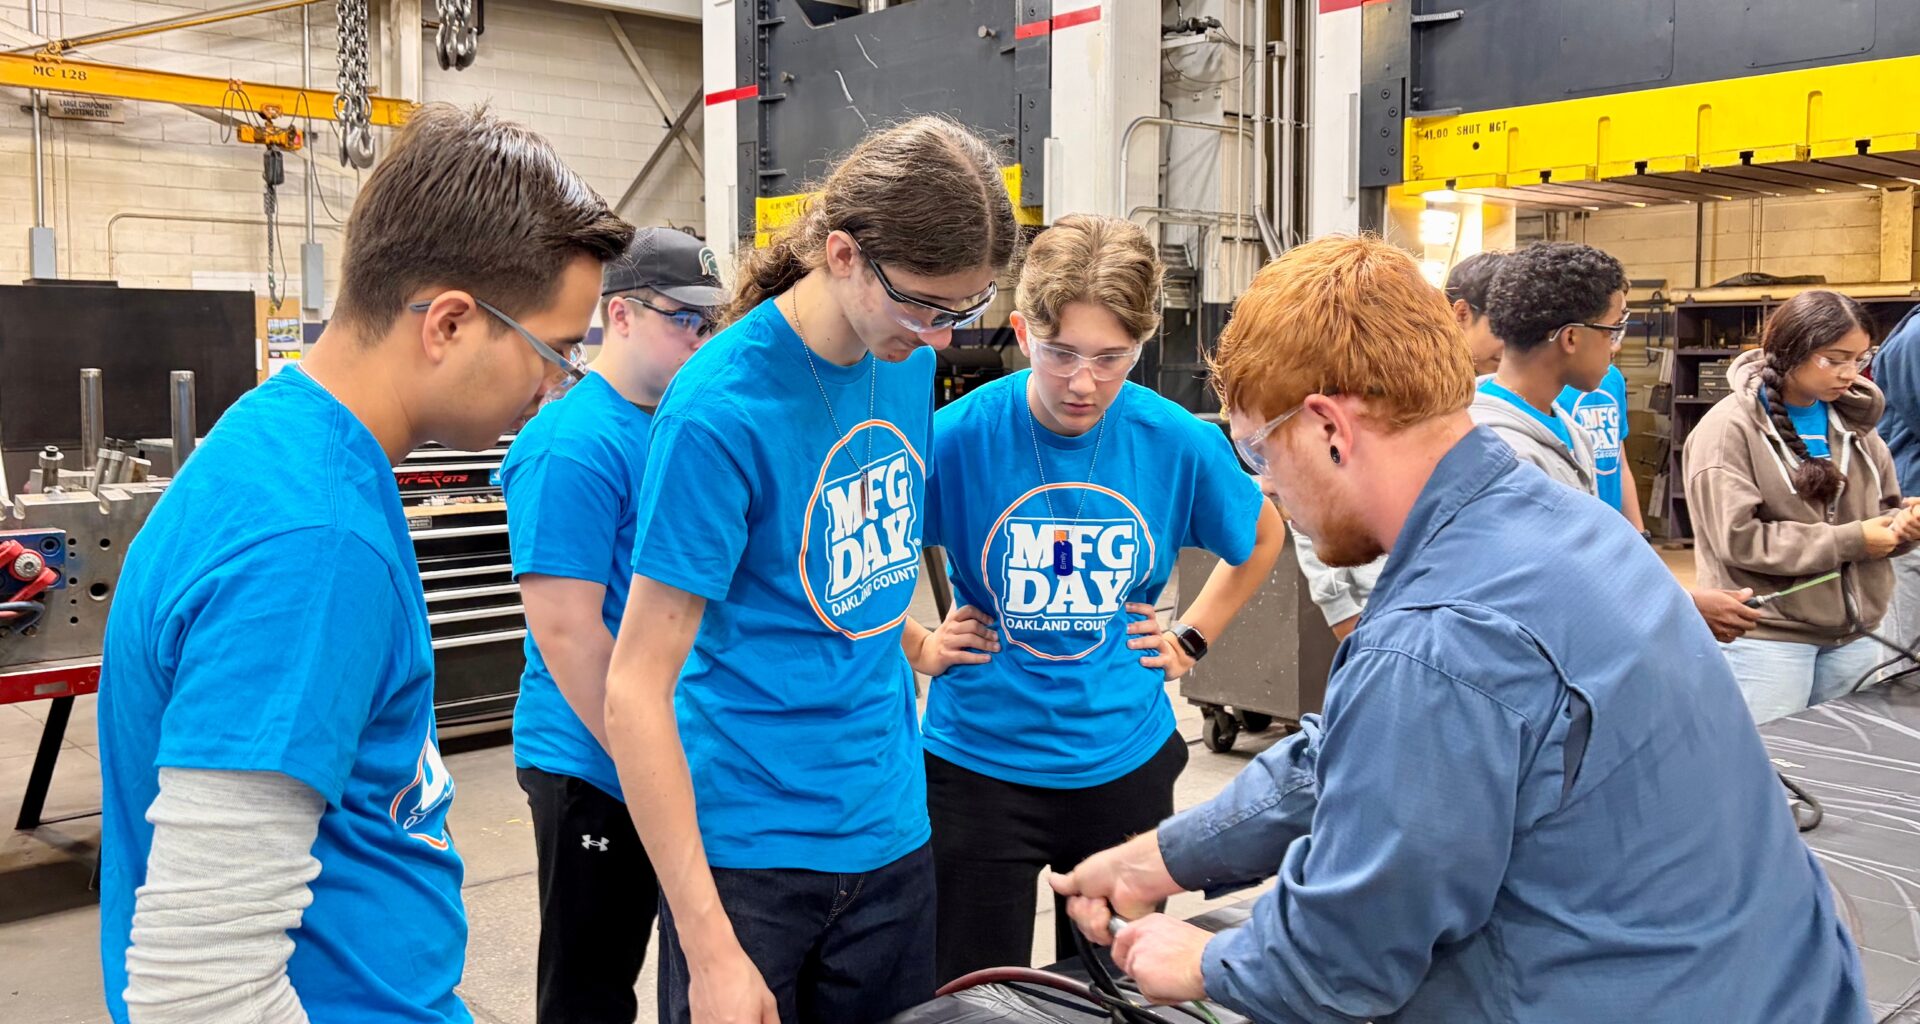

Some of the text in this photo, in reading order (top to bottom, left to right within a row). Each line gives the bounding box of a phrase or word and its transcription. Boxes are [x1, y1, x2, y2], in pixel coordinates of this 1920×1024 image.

[33, 65, 87, 80] MC 128
[59, 100, 112, 110] LARGE COMPONENT
[63, 107, 110, 118] SPOTTING CELL
[1424, 127, 1449, 140] 41.00
[1456, 123, 1481, 136] SHUT
[1579, 406, 1618, 430] MFG
[442, 474, 468, 483] GTS
[827, 456, 908, 543] MFG
[830, 507, 912, 597] DAY
[1009, 523, 1135, 569] MFG
[1060, 552, 1068, 569] Emily
[1006, 569, 1131, 613] DAY
[832, 583, 872, 617] OAKLAND
[1006, 618, 1070, 631] OAKLAND
